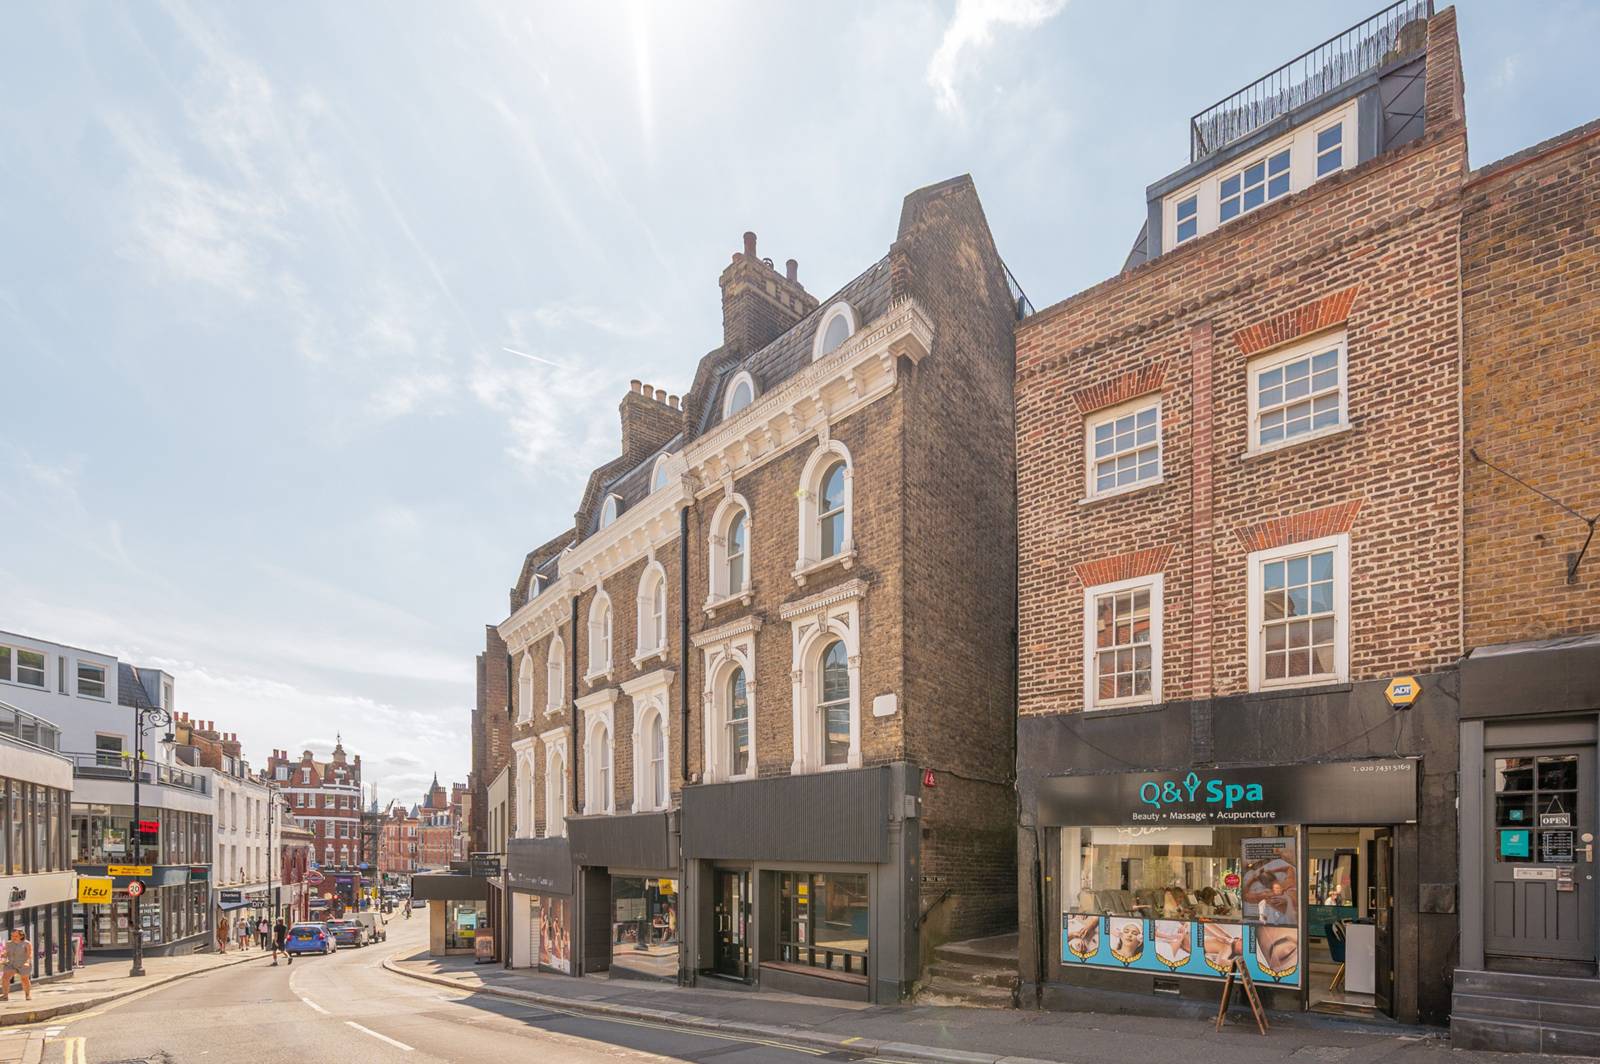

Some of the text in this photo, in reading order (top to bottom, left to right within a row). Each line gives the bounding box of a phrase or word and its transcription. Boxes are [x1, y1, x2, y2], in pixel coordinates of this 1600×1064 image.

[1394, 686, 1411, 695] ADT
[1206, 779, 1263, 809] Spa
[1132, 811, 1276, 821] Beauty Massage Acupuncture
[83, 886, 107, 896] itsu
